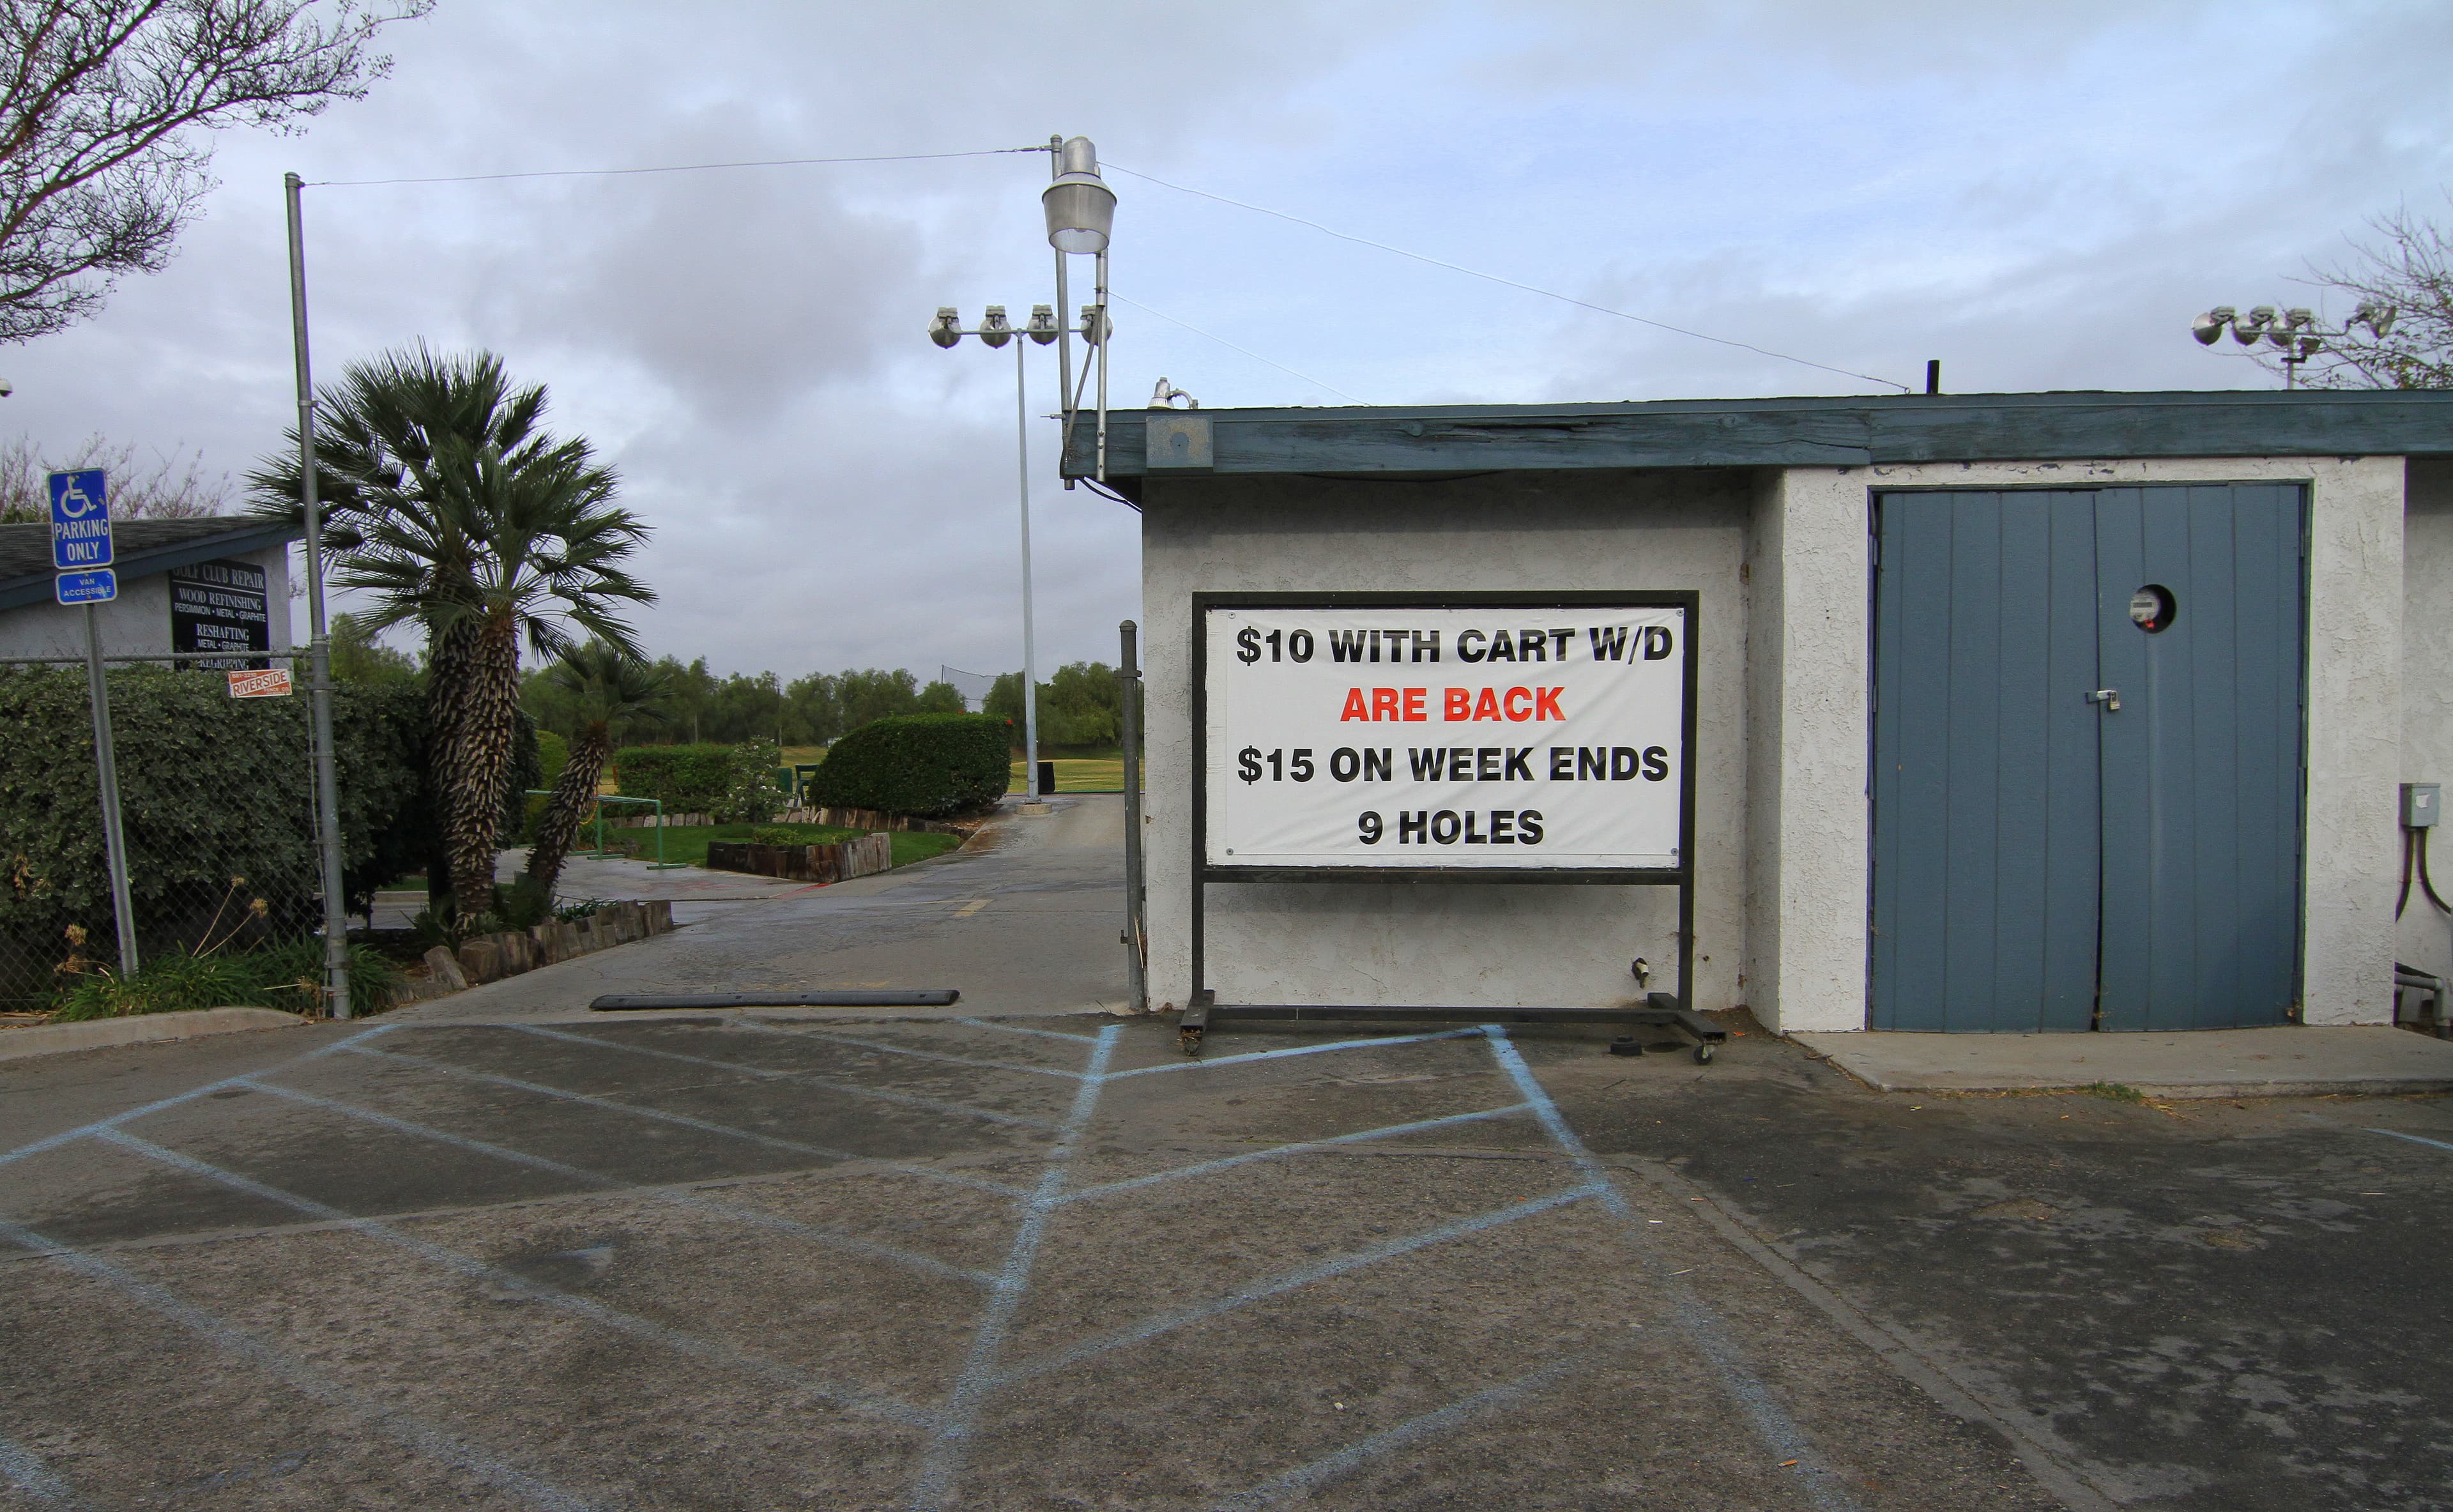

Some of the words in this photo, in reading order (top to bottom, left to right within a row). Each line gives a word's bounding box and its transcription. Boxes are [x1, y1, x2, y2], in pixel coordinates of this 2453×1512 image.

[54, 518, 108, 540] PARKING
[67, 542, 99, 561] ONLY
[203, 564, 229, 583] CLUB
[231, 569, 264, 589] REPAIR
[64, 586, 111, 597] ACCESSIBLE
[179, 588, 206, 603] WOOD
[209, 592, 261, 611] REFINISHING
[174, 602, 211, 616] PERSIMMON
[216, 608, 235, 618] METAL
[239, 611, 266, 622] GRAPHITE
[196, 623, 250, 641] RESHAFTING
[198, 638, 217, 649] METAL
[221, 641, 249, 652] GRAPHITE
[1236, 625, 1315, 667] $10
[1328, 629, 1440, 663] WITH
[1457, 628, 1576, 664] CART
[1589, 625, 1673, 665] W/D
[233, 671, 287, 696] RIVERSIDE
[1340, 687, 1427, 722] ARE
[1444, 686, 1566, 722] BACK
[1237, 745, 1315, 786] $15
[1329, 747, 1392, 783] ON
[1407, 747, 1535, 782] WEEK
[1550, 745, 1669, 782] ENDS
[1358, 811, 1383, 845] 9
[1399, 809, 1544, 845] HOLES
